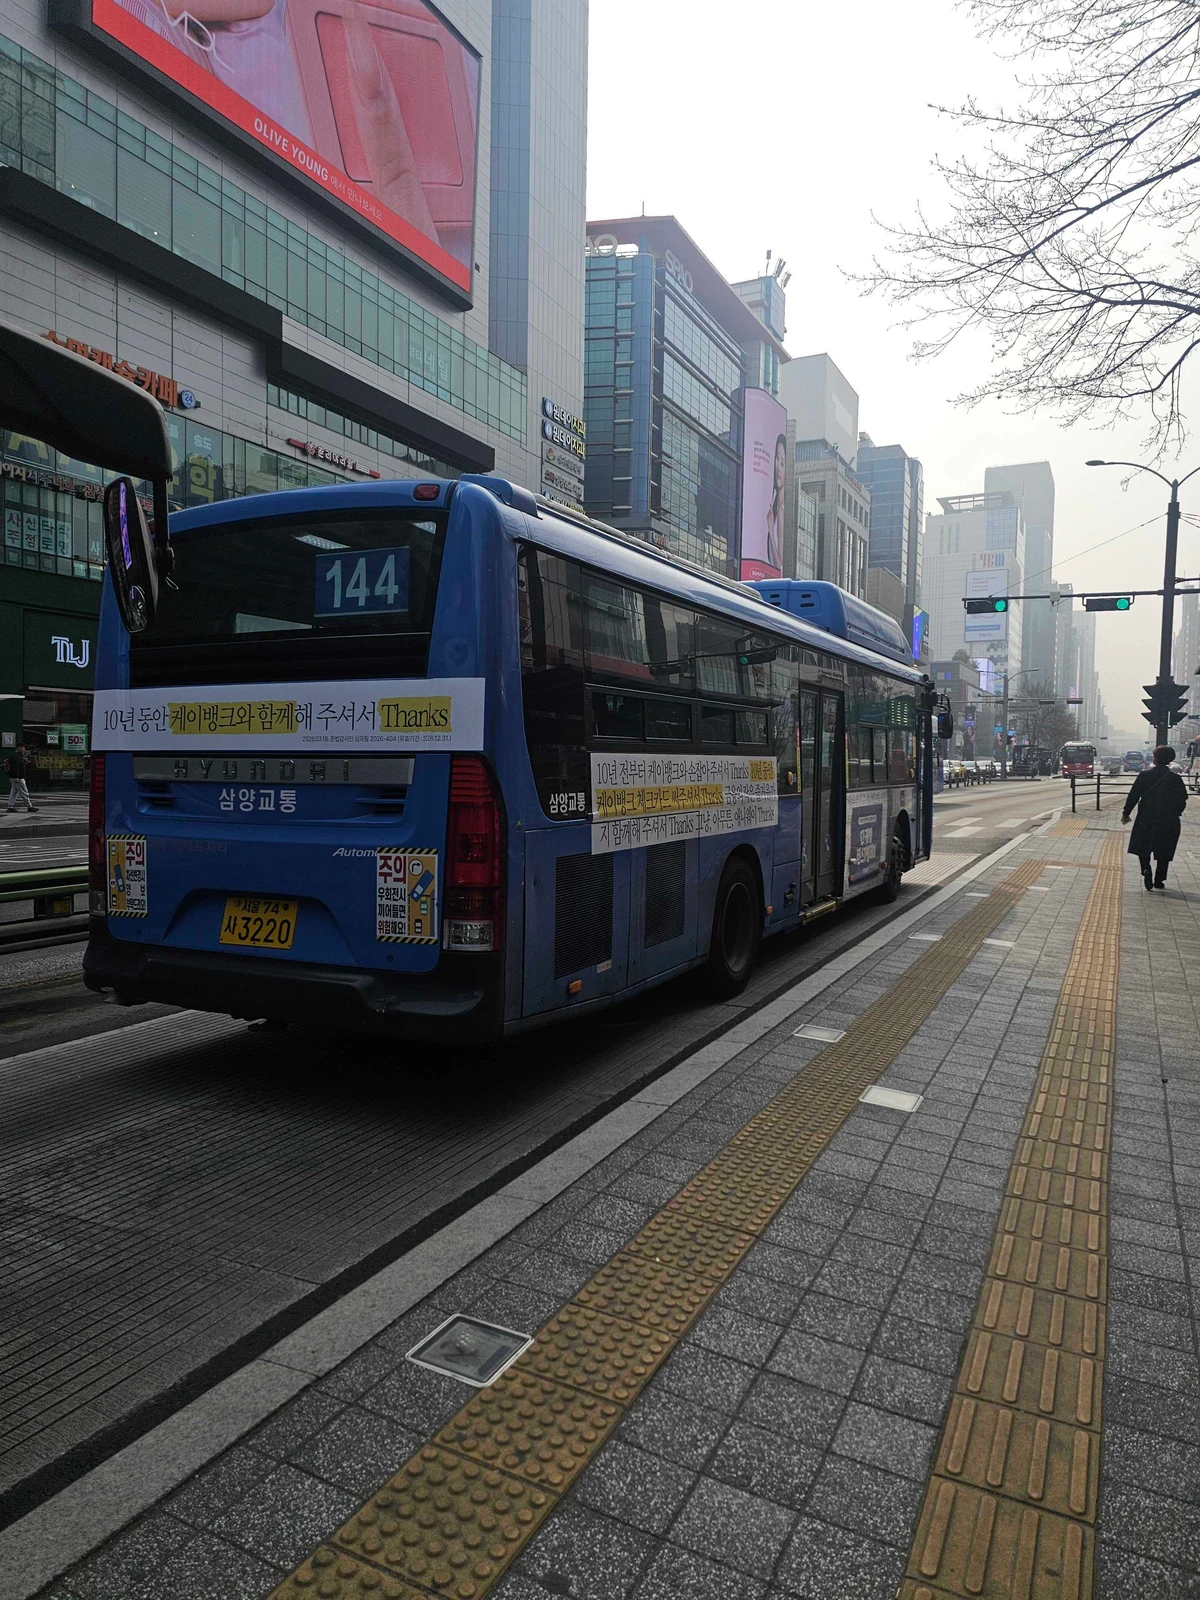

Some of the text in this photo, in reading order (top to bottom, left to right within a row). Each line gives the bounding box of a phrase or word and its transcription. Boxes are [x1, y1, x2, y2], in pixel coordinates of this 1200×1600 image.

[253, 118, 383, 221] OLIVE YOUNG 에서 만나보세요
[664, 248, 694, 294] SPAO
[184, 392, 194, 403] 24
[553, 404, 586, 439] 원데이치과
[552, 426, 586, 460] 원데이치과
[6, 511, 21, 545] 사주
[25, 516, 36, 548] 신점
[980, 553, 1005, 567] YBM
[324, 553, 400, 610] 144
[51, 636, 90, 669] TLJ
[103, 700, 448, 733] 10년 동안 케이뱅크와 함께해 주셔서 Thanks
[173, 759, 349, 782] HYUNDAI
[596, 759, 618, 785] 10년
[619, 760, 647, 786] 전부터
[647, 760, 687, 784] 케이뱅크와
[688, 760, 710, 783] 손잡아
[730, 763, 749, 780] Thanks
[762, 760, 774, 780] 동안
[218, 788, 297, 813] 삼양교통
[549, 792, 585, 814] 삼양교통
[596, 789, 637, 818] 케이뱅크
[637, 788, 671, 813] 체크카드
[700, 787, 723, 806] Thanks
[600, 822, 610, 848] 지
[612, 818, 640, 846] 함께해
[642, 815, 667, 842] 주셔서
[668, 814, 694, 836] Thanks
[695, 810, 711, 834] 그냥,
[712, 808, 734, 831] 아무튼,
[757, 805, 775, 823] Thanks
[126, 841, 145, 867] 주의
[378, 855, 407, 884] 주의
[241, 901, 280, 914] 서울 74
[377, 887, 407, 902] 우회전시
[377, 903, 407, 919] 끼어들면
[224, 915, 290, 945] 사 3220
[377, 920, 407, 936] 위험해요!
